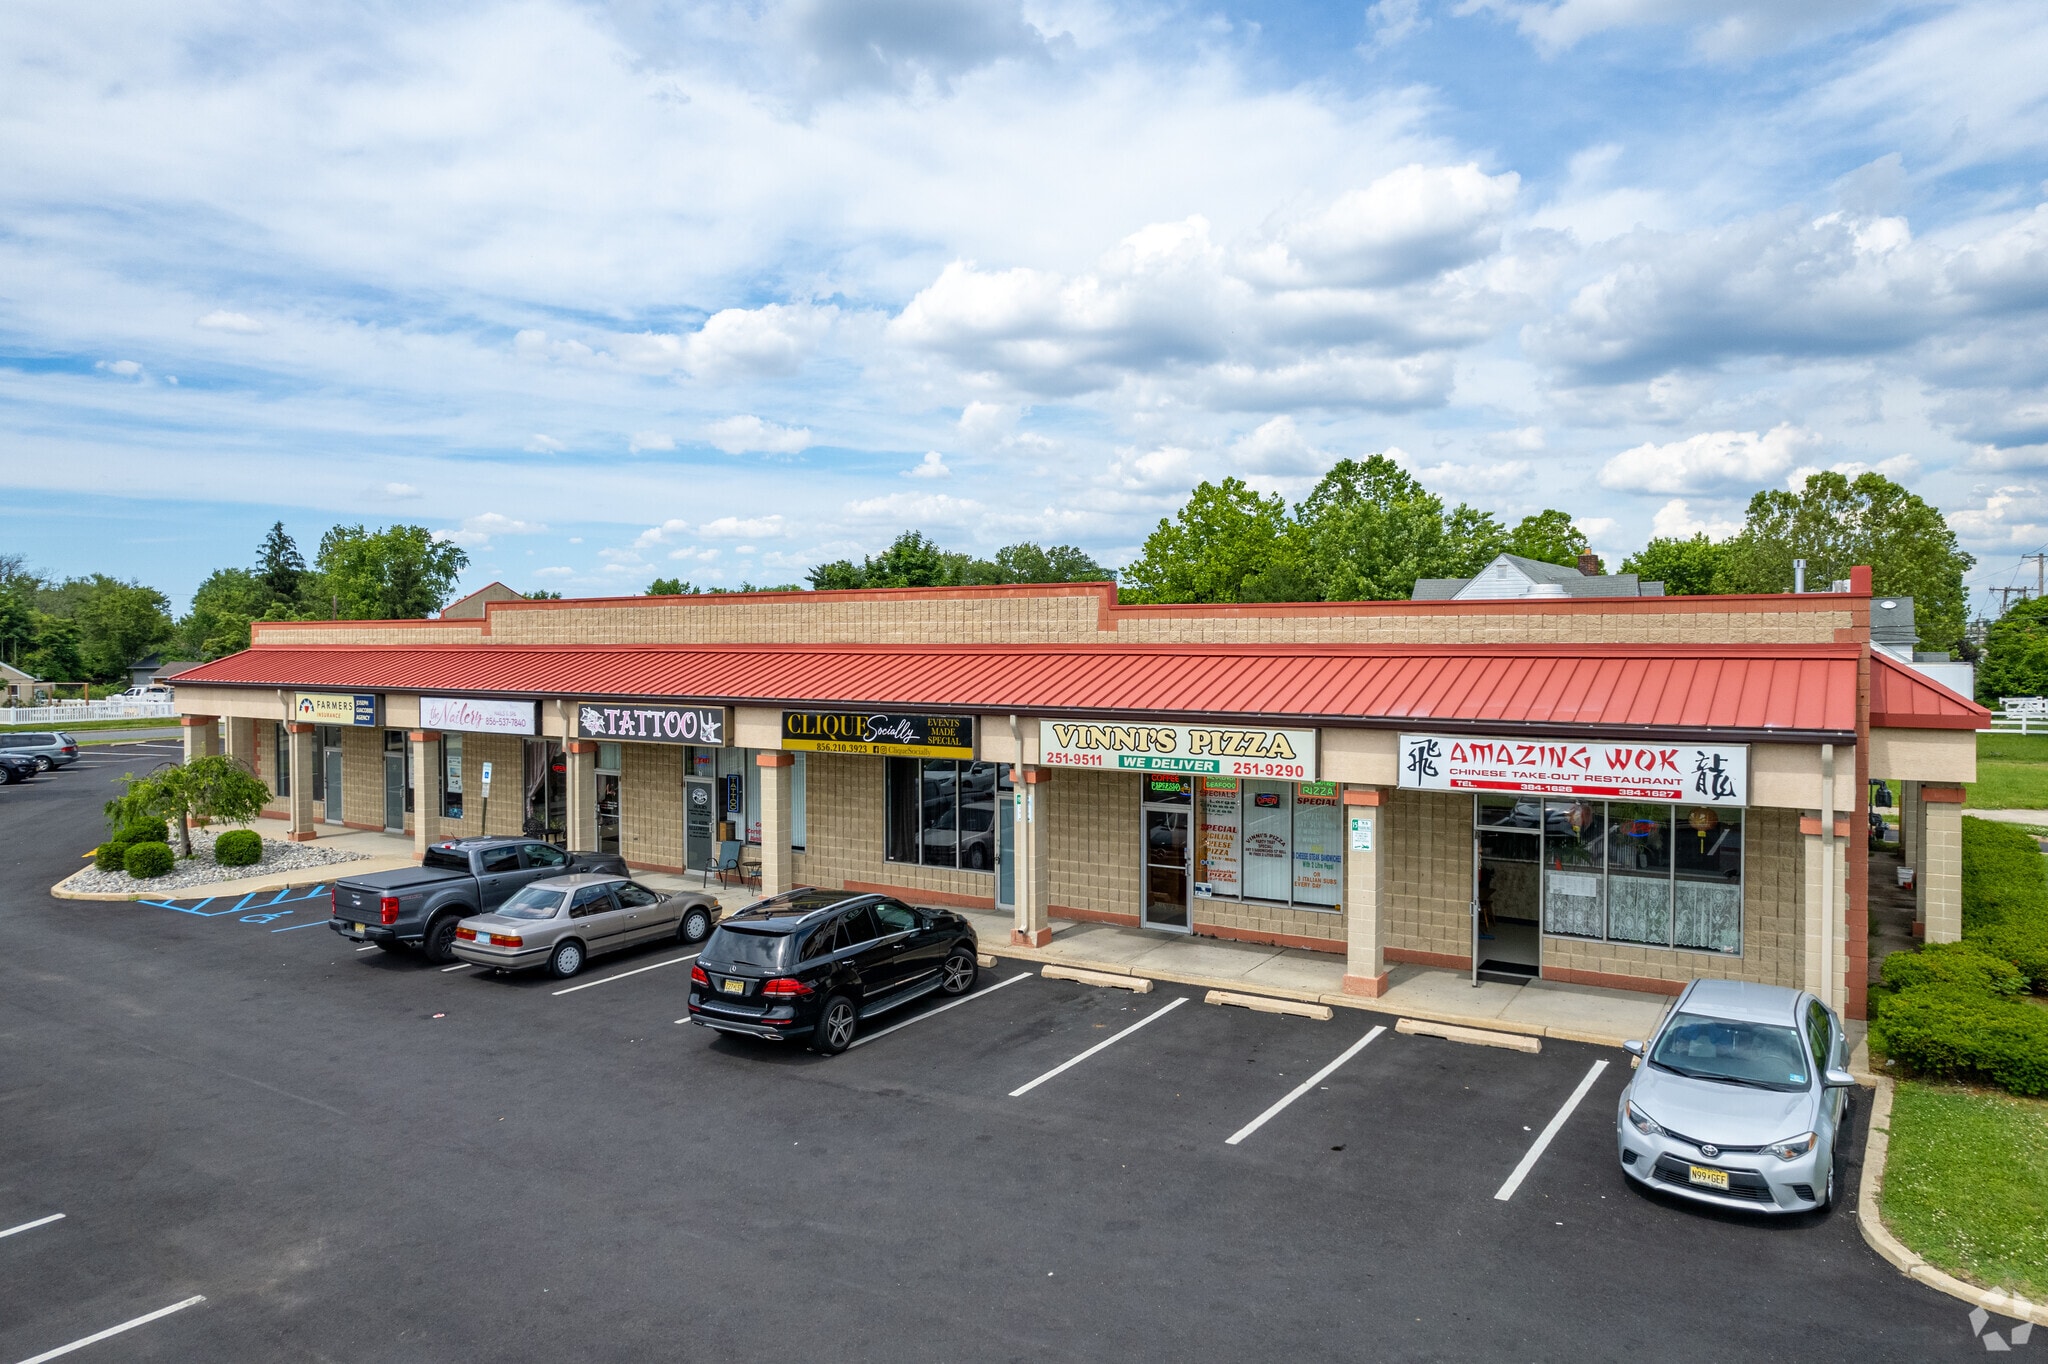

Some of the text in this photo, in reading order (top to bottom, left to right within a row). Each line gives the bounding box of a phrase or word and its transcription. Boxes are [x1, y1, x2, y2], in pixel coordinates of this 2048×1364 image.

[316, 700, 353, 711] FARMERS
[316, 711, 341, 719] INSURANCE
[429, 701, 482, 728] Nailery
[485, 717, 526, 728] 856-537-7840
[604, 708, 698, 738] TATTOO
[927, 717, 960, 728] EVENTS
[787, 714, 920, 744] CLIQUE Socially
[931, 727, 956, 737] MADE
[927, 736, 962, 746] SPECIAL
[1053, 724, 1296, 759] VINNI'S PIZZA
[816, 743, 867, 753] 856.210.3923
[1047, 752, 1102, 766] 251-9511
[1450, 742, 1682, 774] AMAZING WOK
[1123, 756, 1214, 772] WE DELIVER
[1233, 762, 1304, 778] 251-9290
[1151, 773, 1179, 782] COFFEE
[1450, 768, 1684, 786] CHINESE TAKE-OUT RESTAURANT
[1456, 780, 1478, 788] TEL.
[1521, 783, 1573, 792] 384-1626
[1200, 790, 1236, 798] SPECIALS
[1302, 786, 1334, 796] PIZZA
[1618, 788, 1675, 798] 384-1627
[1256, 797, 1278, 805] OPEN
[1297, 797, 1337, 806] SPECIAL
[1200, 823, 1238, 833] SPECIAL
[1269, 834, 1286, 847] PIZZA
[1206, 848, 1229, 857] PIZZA
